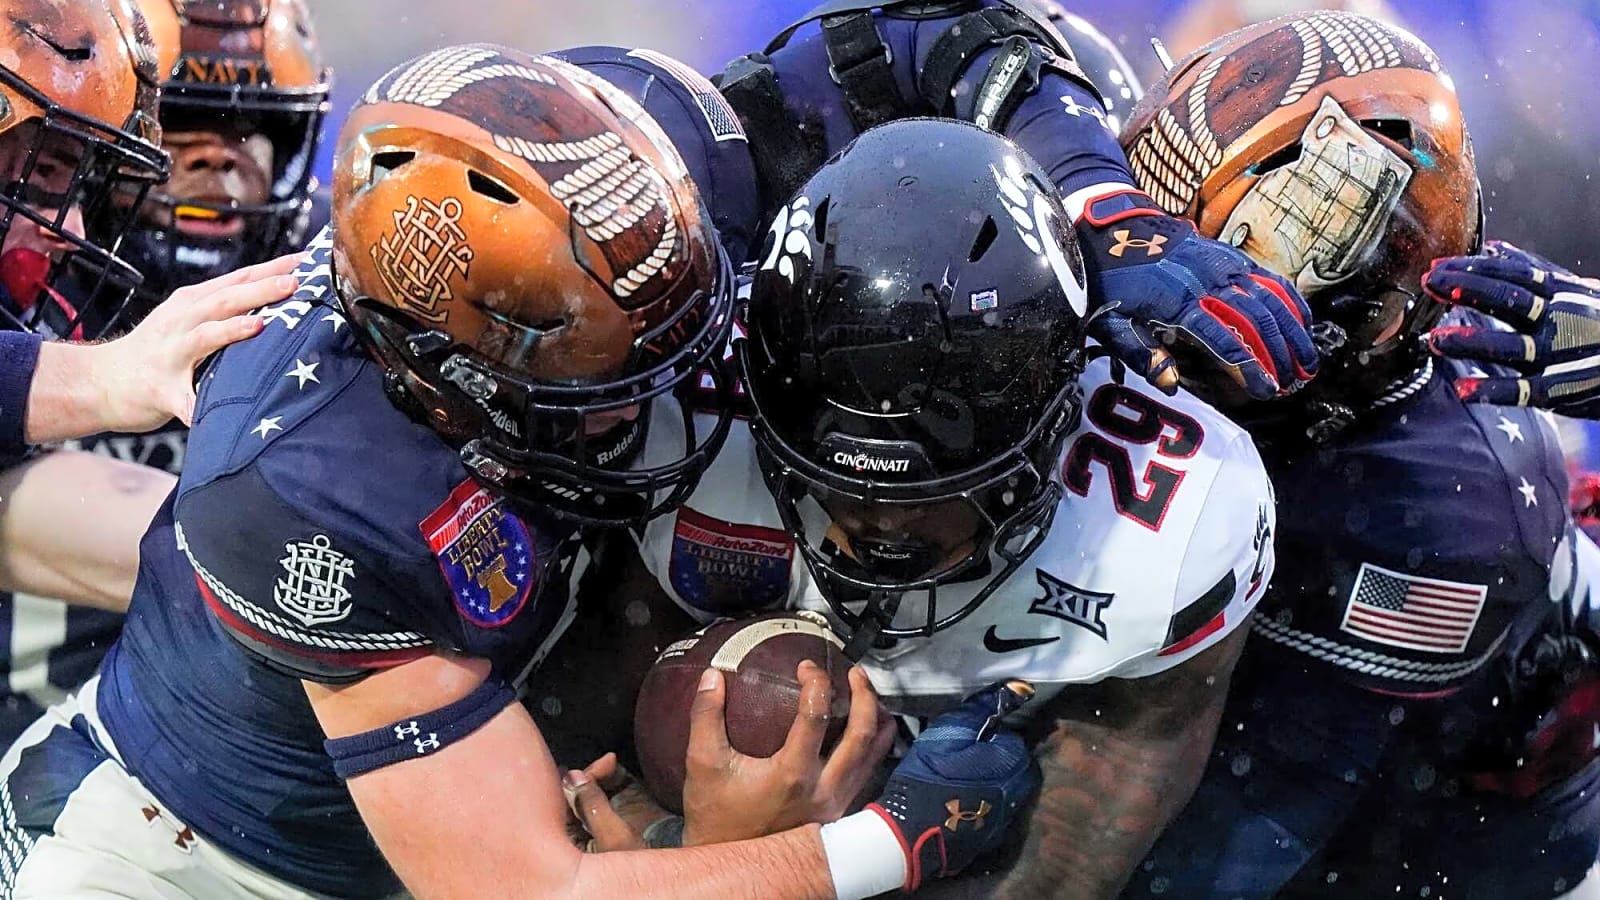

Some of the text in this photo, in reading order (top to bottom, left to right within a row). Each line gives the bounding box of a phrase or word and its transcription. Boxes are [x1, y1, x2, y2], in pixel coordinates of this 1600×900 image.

[833, 451, 910, 473] CINCINNATI
[1061, 382, 1205, 533] 29
[457, 494, 495, 531] AtoZo
[461, 527, 508, 582] BOWL
[713, 536, 787, 557] AutoZone
